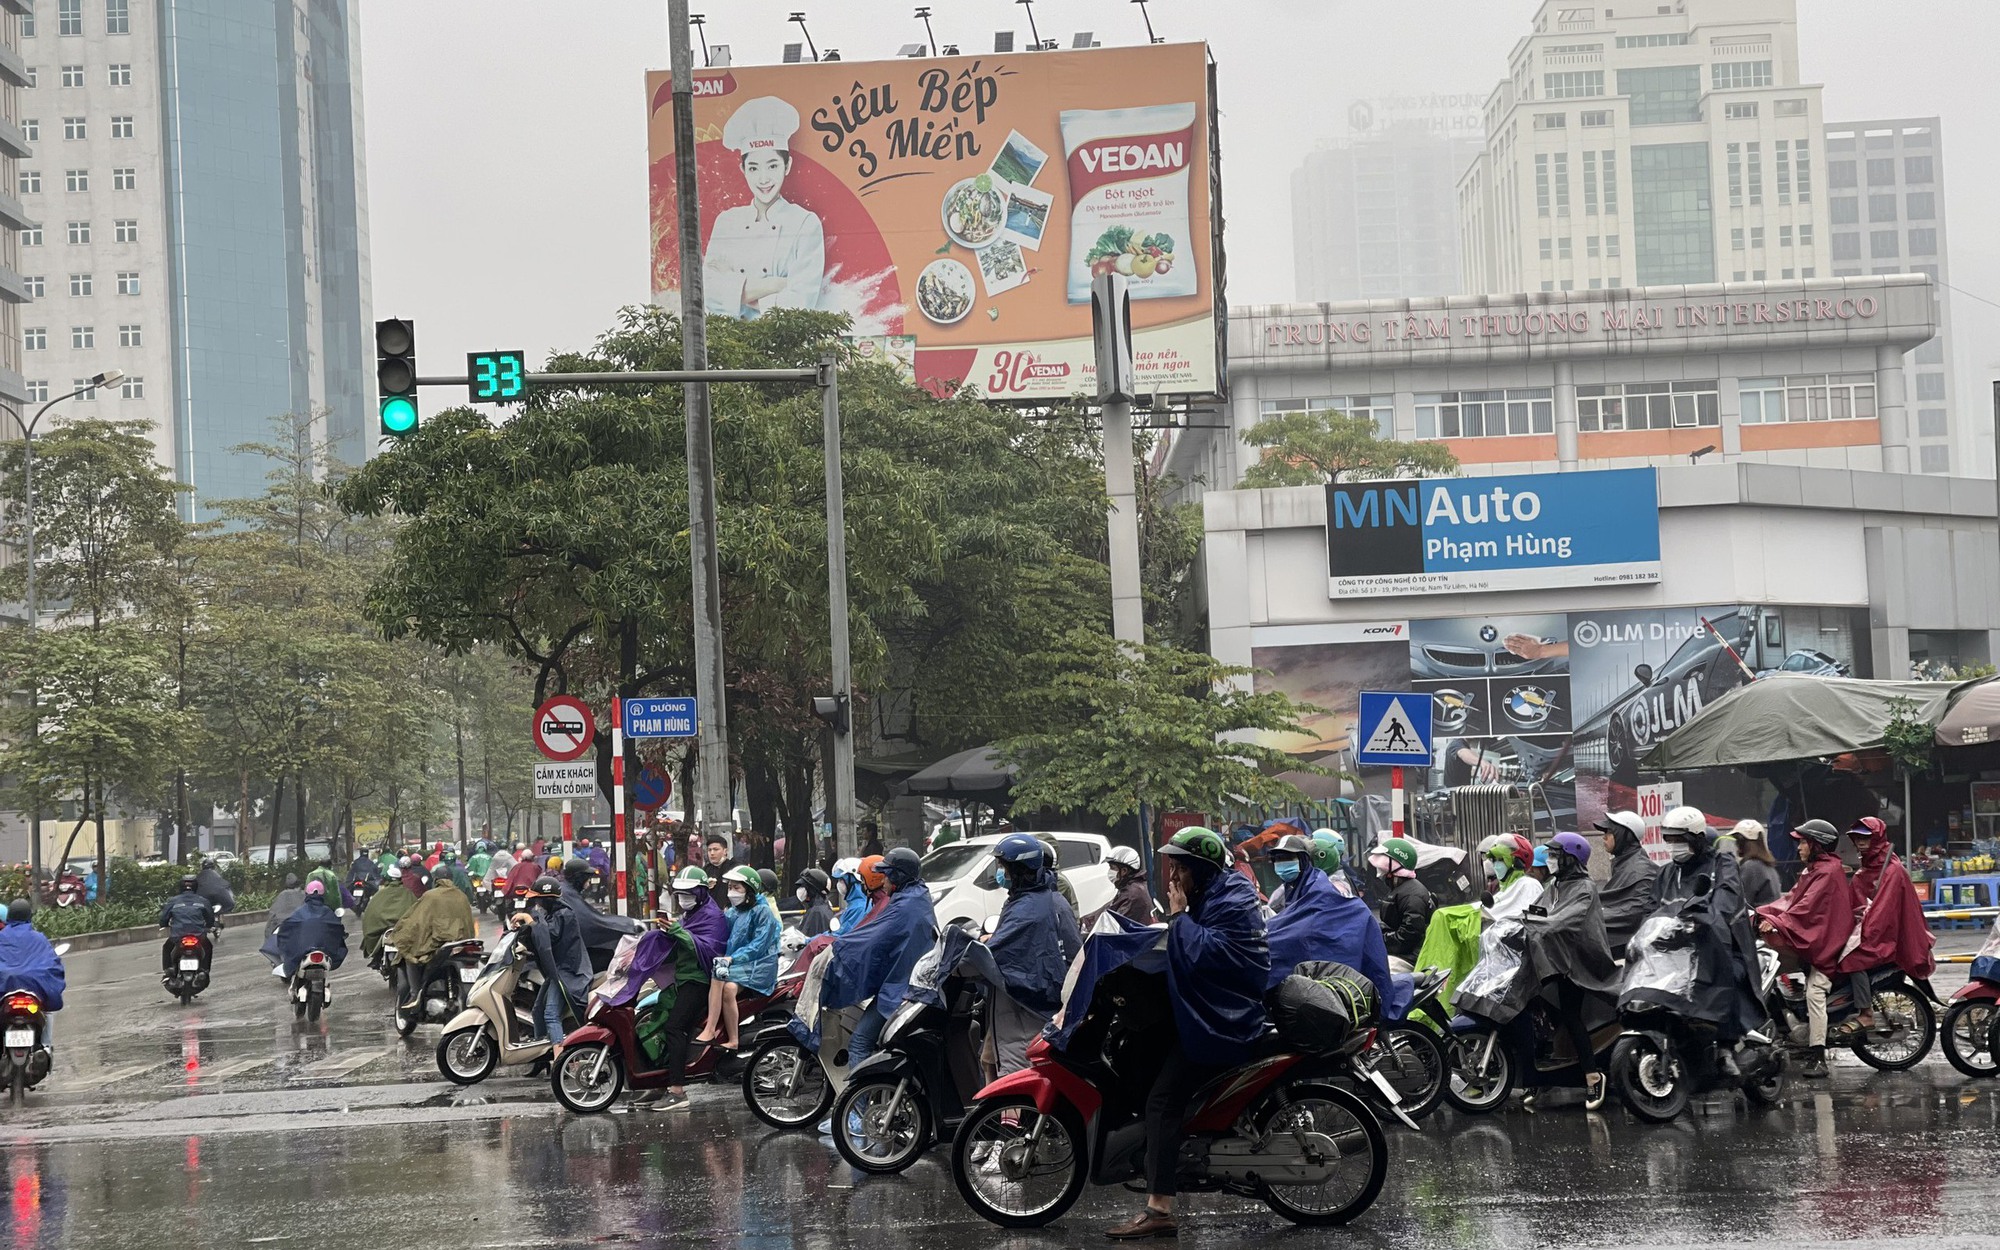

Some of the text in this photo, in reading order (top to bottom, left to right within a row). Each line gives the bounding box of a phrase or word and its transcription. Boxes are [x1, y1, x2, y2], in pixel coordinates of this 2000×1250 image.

[692, 80, 724, 95] DAN
[811, 61, 998, 153] Siêu Bếp
[749, 140, 774, 148] VEDAN
[849, 117, 982, 178] 3 Miền
[1079, 142, 1183, 174] VEDAN
[1105, 187, 1155, 202] Bột ngọt
[1266, 295, 1878, 346] TRUNG TÂM THƯƠNG MẠI INTERSERCO
[1136, 348, 1178, 361] tạo nên
[1030, 366, 1064, 376] VEDAN
[1135, 361, 1190, 372] món ngon
[476, 355, 522, 397] 33
[1334, 486, 1541, 529] MN Auto
[1427, 532, 1572, 563] Phạm Hùng
[1338, 578, 1356, 586] CÔNG
[1375, 577, 1393, 585] CÔNG
[1394, 576, 1411, 584] NGHỆ
[1363, 626, 1396, 635] KONI
[1602, 622, 1706, 642] JLM Drive
[650, 702, 687, 713] ĐƯỜNG
[1651, 676, 1704, 734] JLM
[633, 716, 690, 735] PHẠM HÙNG
[536, 766, 594, 780] CẤM XE KHÁCH
[537, 781, 562, 795] TUYẾN
[563, 780, 574, 794] CỐ
[1641, 790, 1661, 818] XÔI
[1393, 847, 1409, 860] Grab
